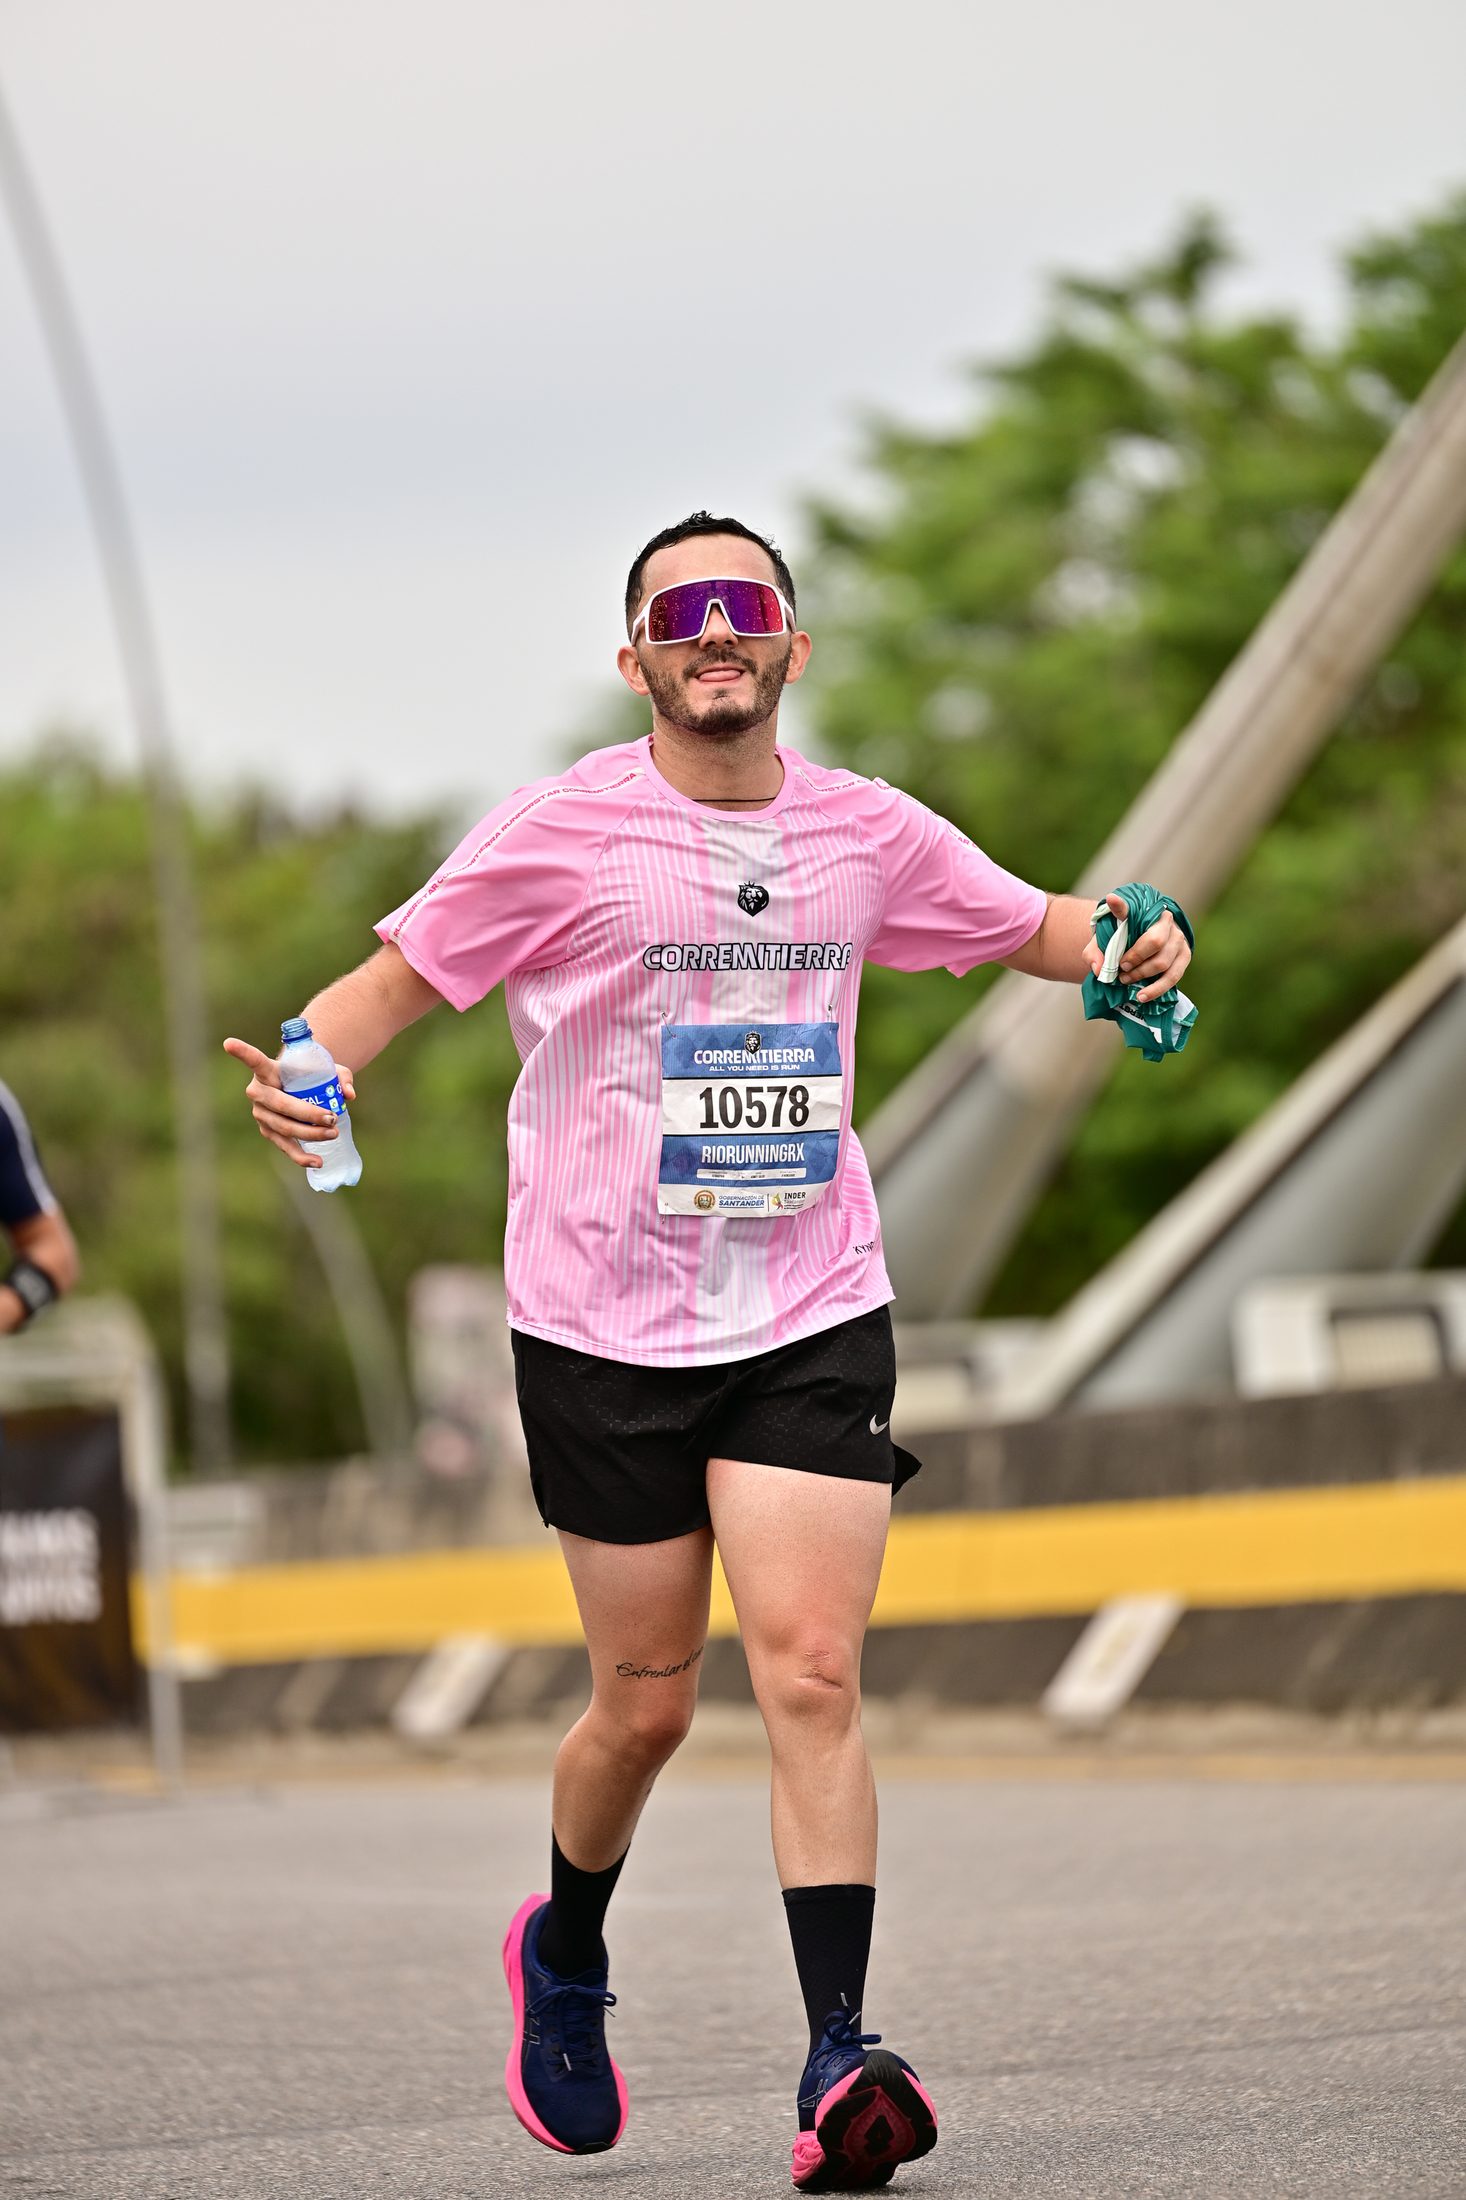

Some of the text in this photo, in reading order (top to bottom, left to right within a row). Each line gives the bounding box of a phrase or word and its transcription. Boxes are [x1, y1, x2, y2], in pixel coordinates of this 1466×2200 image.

[501, 789, 560, 832] RUNNERSTAR
[643, 943, 853, 972] CORREMITIERRA
[694, 1048, 815, 1064] CORREMITIERRA
[699, 1084, 810, 1129] 10578
[701, 1142, 805, 1164] RIORUNNINGRX
[784, 1192, 807, 1200] INDER
